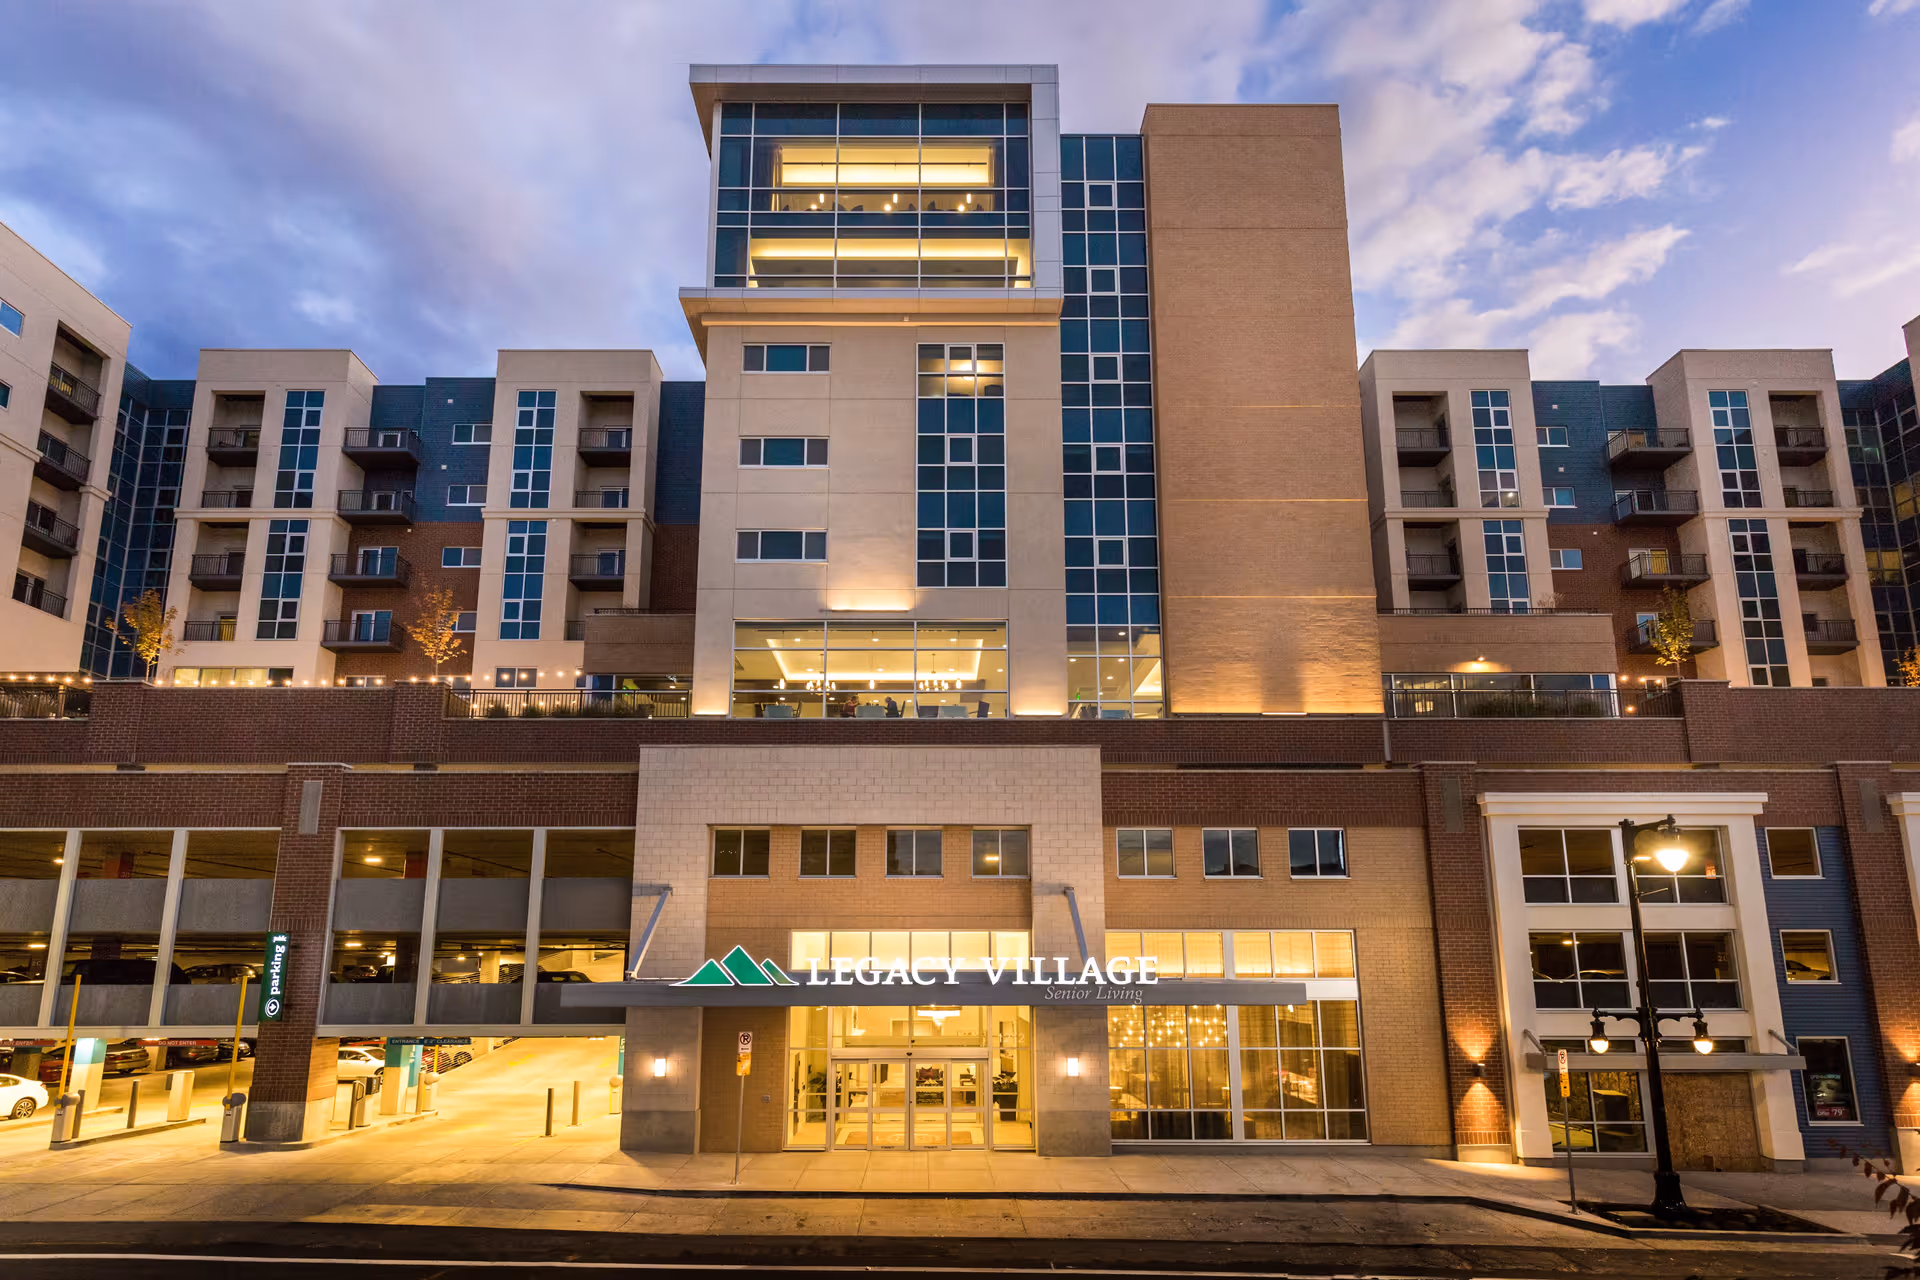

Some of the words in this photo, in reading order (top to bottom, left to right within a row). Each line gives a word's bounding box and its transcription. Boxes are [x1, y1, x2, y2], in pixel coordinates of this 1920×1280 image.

[270, 945, 286, 995] parking
[806, 957, 966, 986] LEGACY
[978, 956, 1159, 986] VILLAGE
[1045, 986, 1092, 1000] Senior
[1096, 986, 1143, 1005] Living
